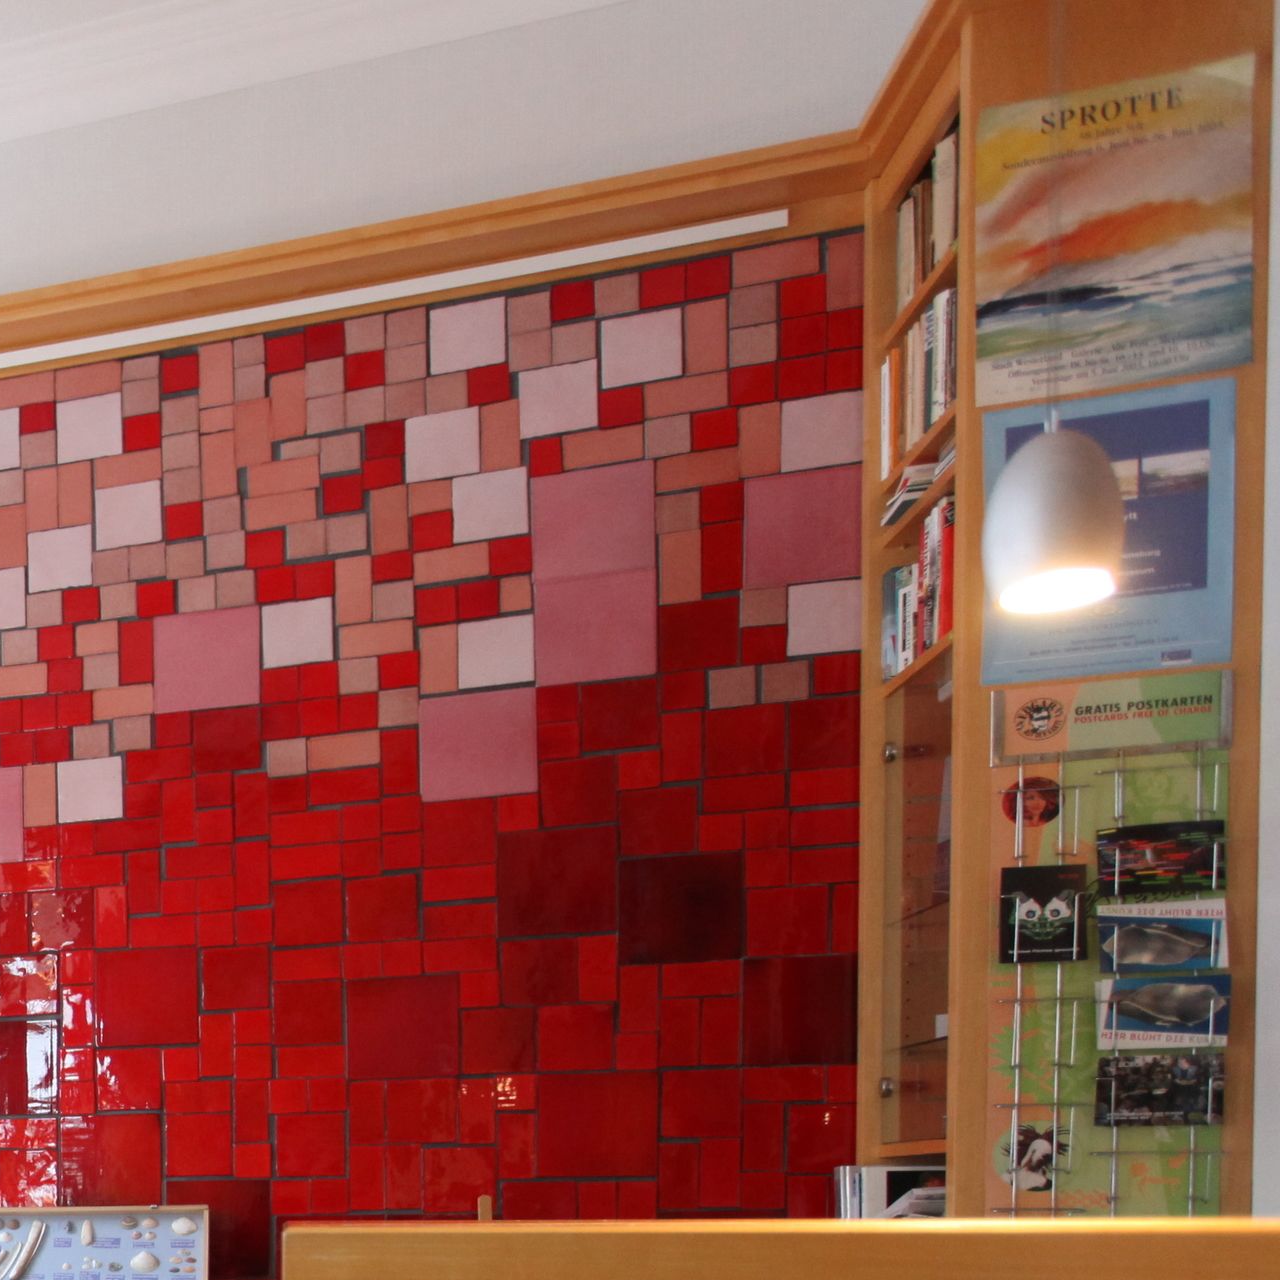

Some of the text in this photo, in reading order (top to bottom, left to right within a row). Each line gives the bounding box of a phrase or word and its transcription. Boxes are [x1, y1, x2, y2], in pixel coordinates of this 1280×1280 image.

[1041, 87, 1183, 134] SPROTTE
[1074, 712, 1129, 724] POSTCARDS
[1132, 710, 1154, 719] FREE
[1174, 705, 1213, 716] CHARGE
[1075, 695, 1214, 717] GRATIS POSTKARTEN
